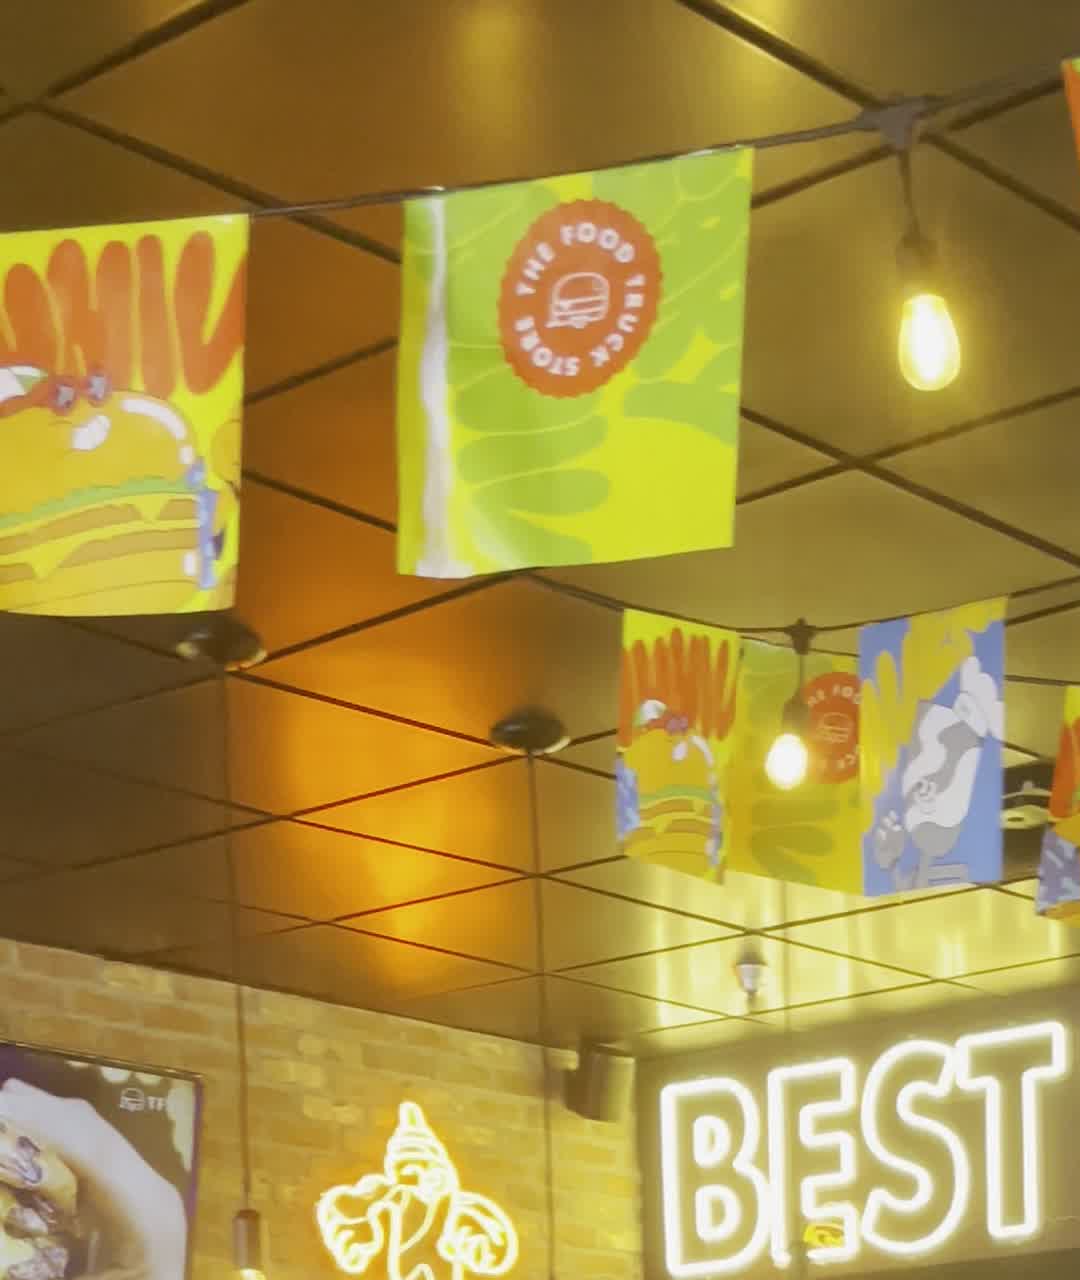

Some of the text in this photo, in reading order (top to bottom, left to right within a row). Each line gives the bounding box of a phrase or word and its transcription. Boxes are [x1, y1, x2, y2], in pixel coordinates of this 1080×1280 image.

[514, 221, 646, 376] THE FOOD TRUCK STORE
[659, 1019, 1069, 1280] BEST
